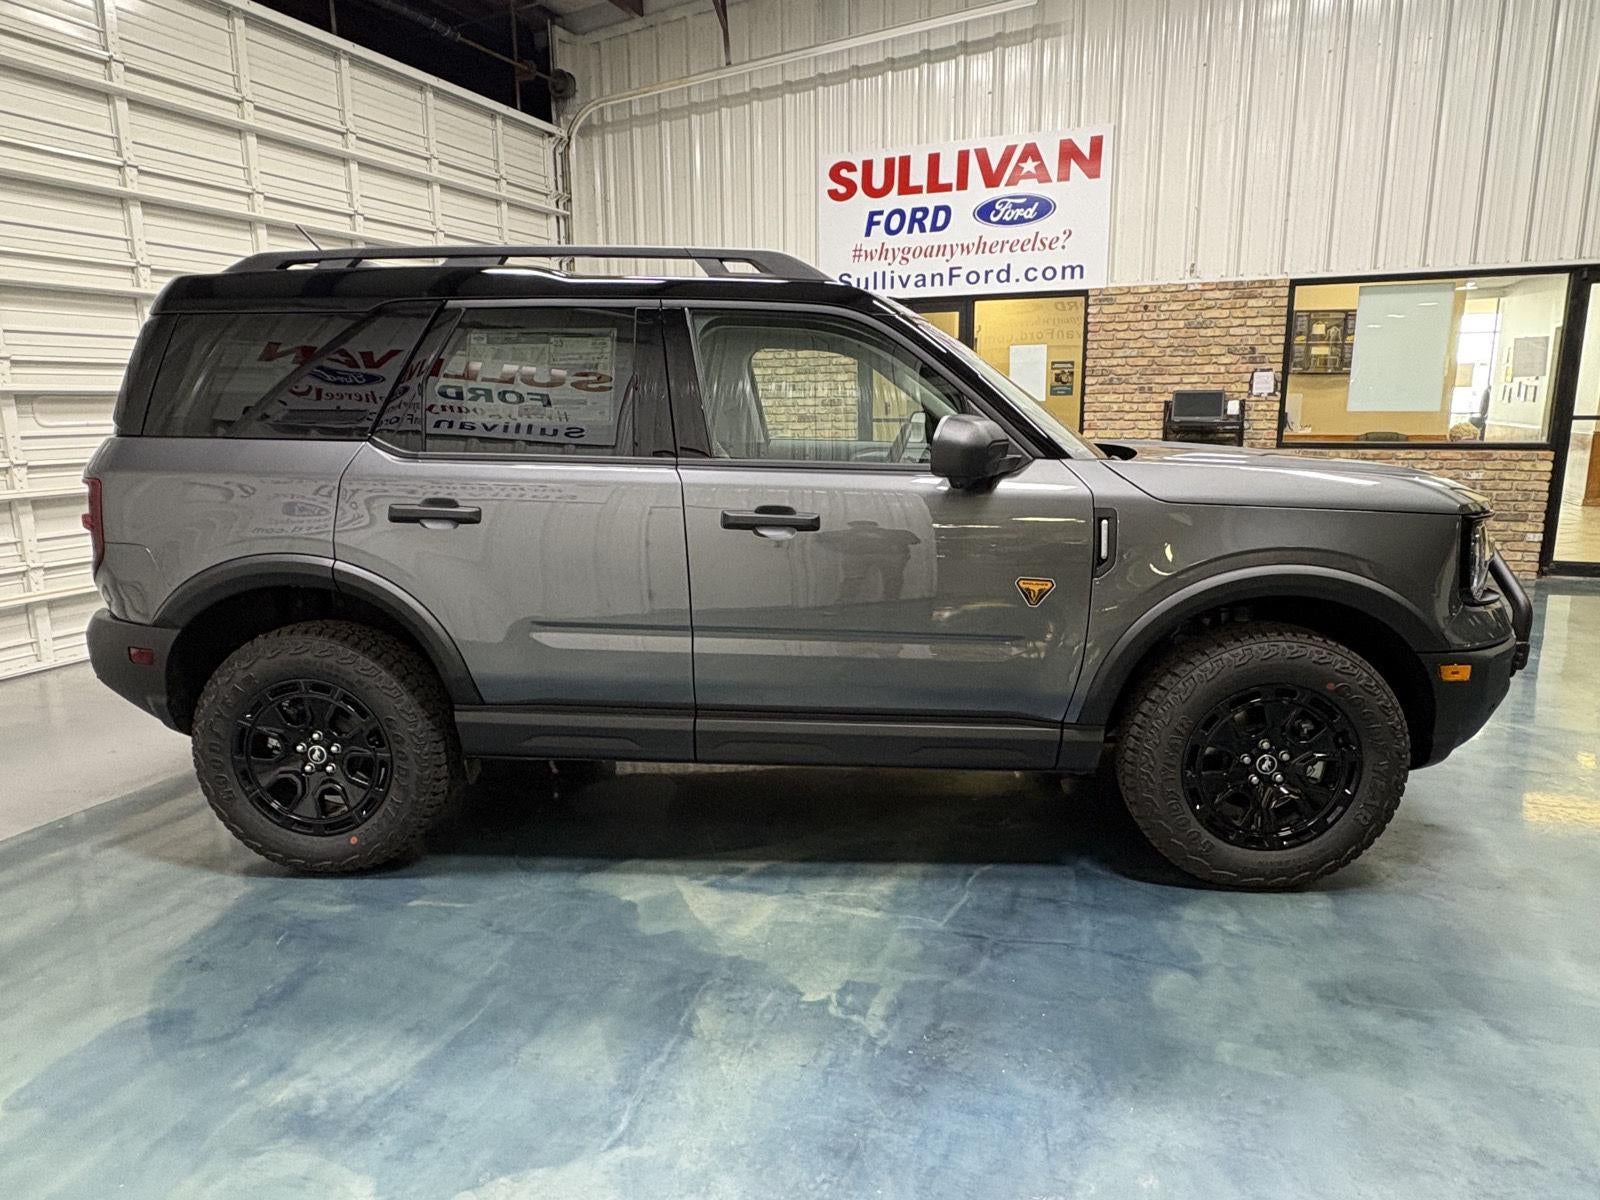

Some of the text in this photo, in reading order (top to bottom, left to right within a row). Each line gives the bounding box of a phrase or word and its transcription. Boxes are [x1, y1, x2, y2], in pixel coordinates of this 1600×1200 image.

[827, 134, 1104, 202] SULLIVAN
[864, 204, 953, 238] FORD
[990, 197, 1039, 222] Ford
[852, 228, 1073, 266] #whygoanywhereelse?
[838, 262, 1085, 291] SullivanFord.com
